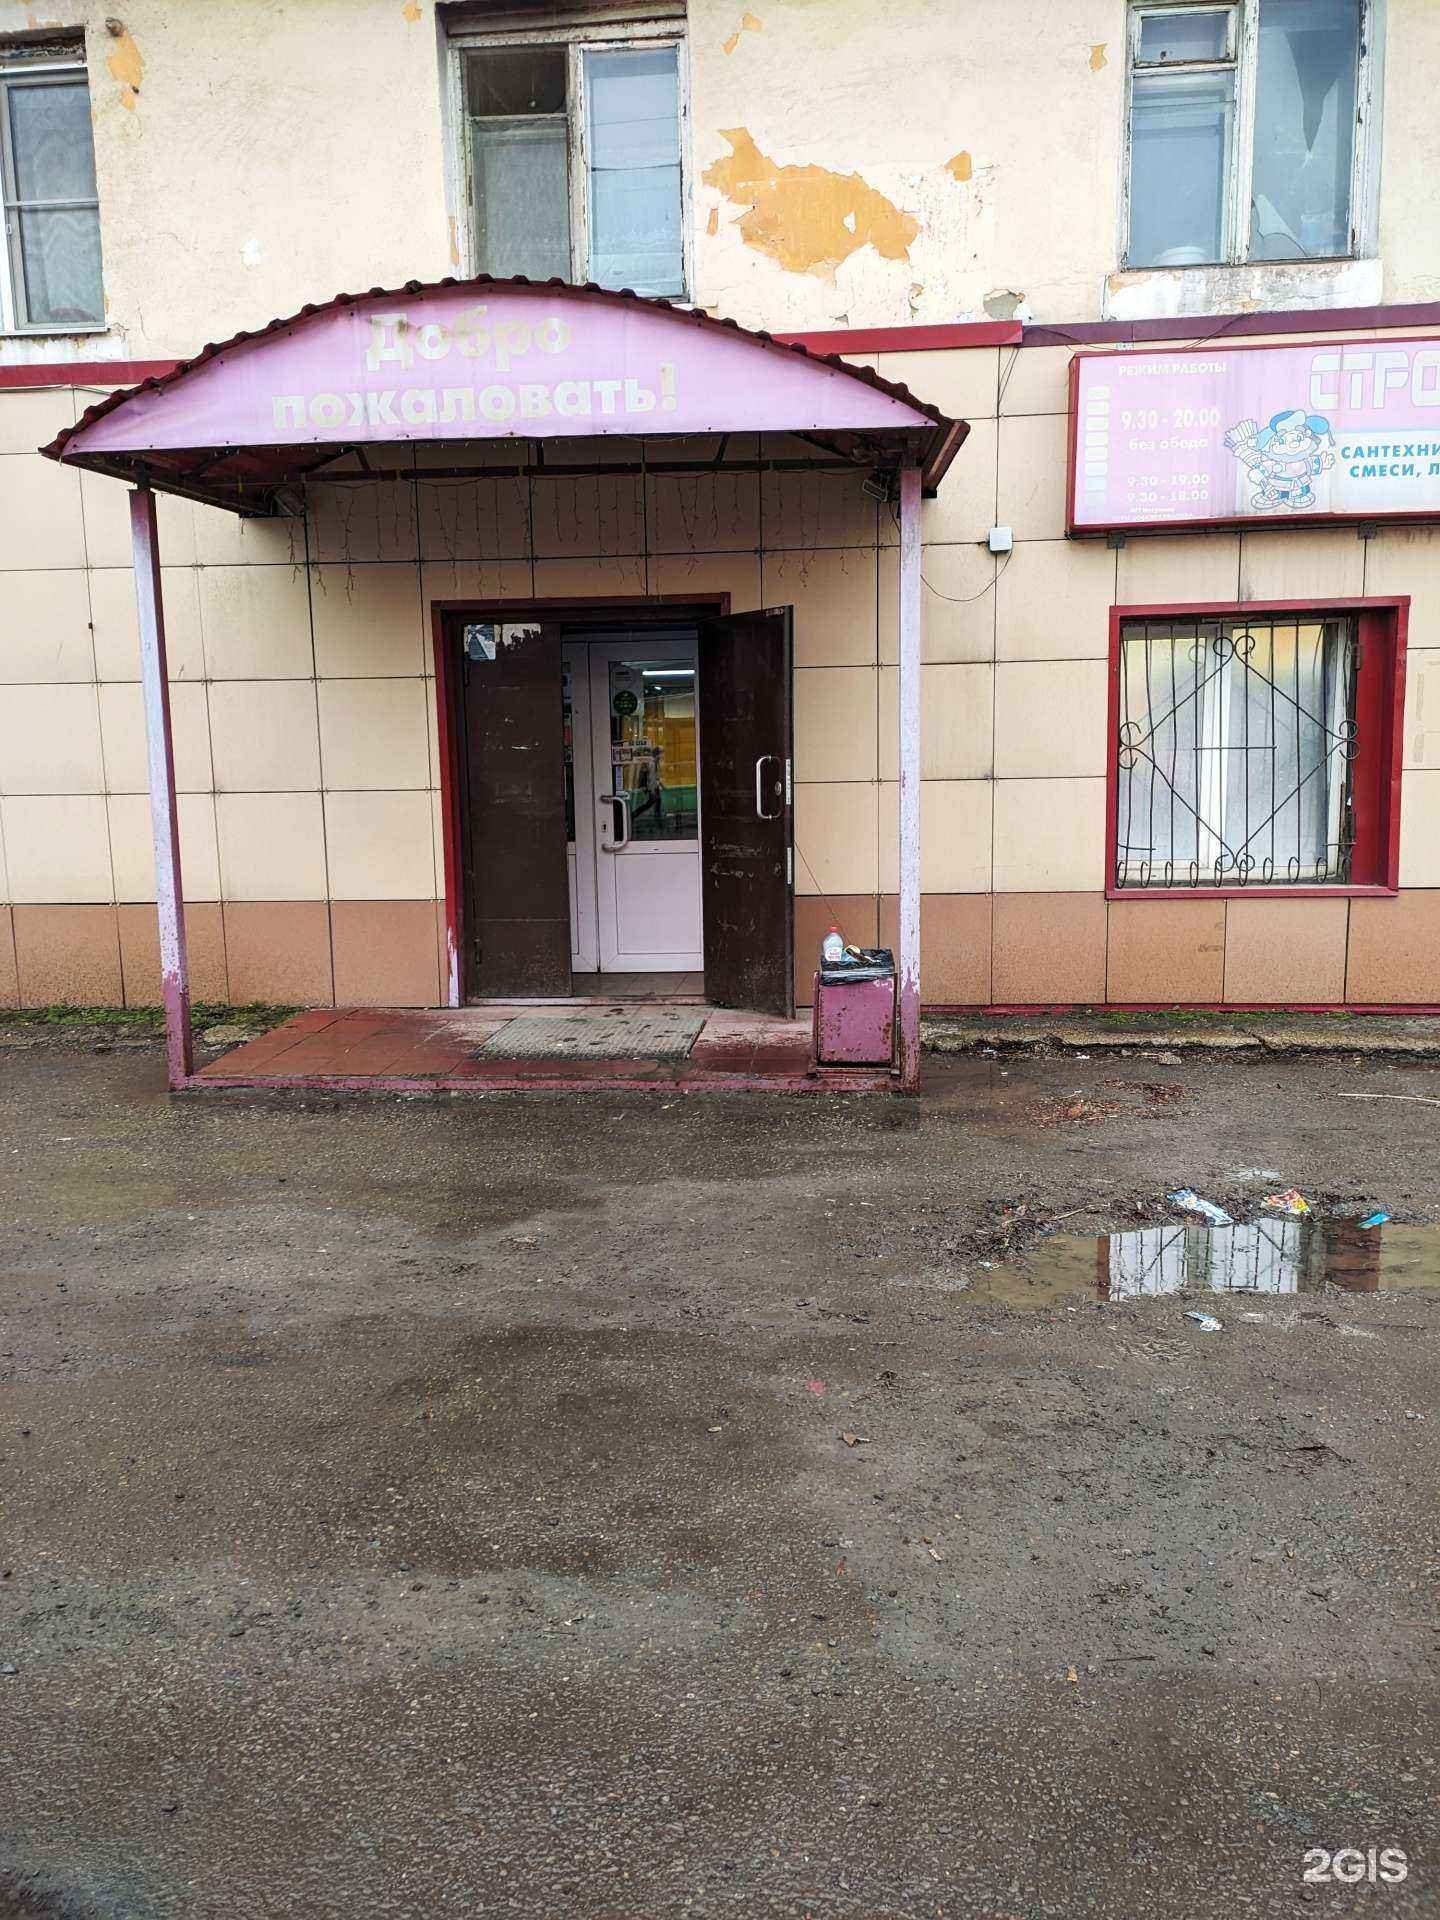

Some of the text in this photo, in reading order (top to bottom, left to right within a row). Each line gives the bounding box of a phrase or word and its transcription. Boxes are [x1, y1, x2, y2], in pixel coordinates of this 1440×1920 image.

[365, 305, 572, 372] Добро
[1118, 361, 1227, 377] РЕЖИМ РАБОТЫ
[271, 361, 678, 430] пожаловать!
[1121, 409, 1158, 431] 9.30
[1172, 407, 1221, 429] 20.00
[1349, 462, 1422, 478] СМЕСИ,
